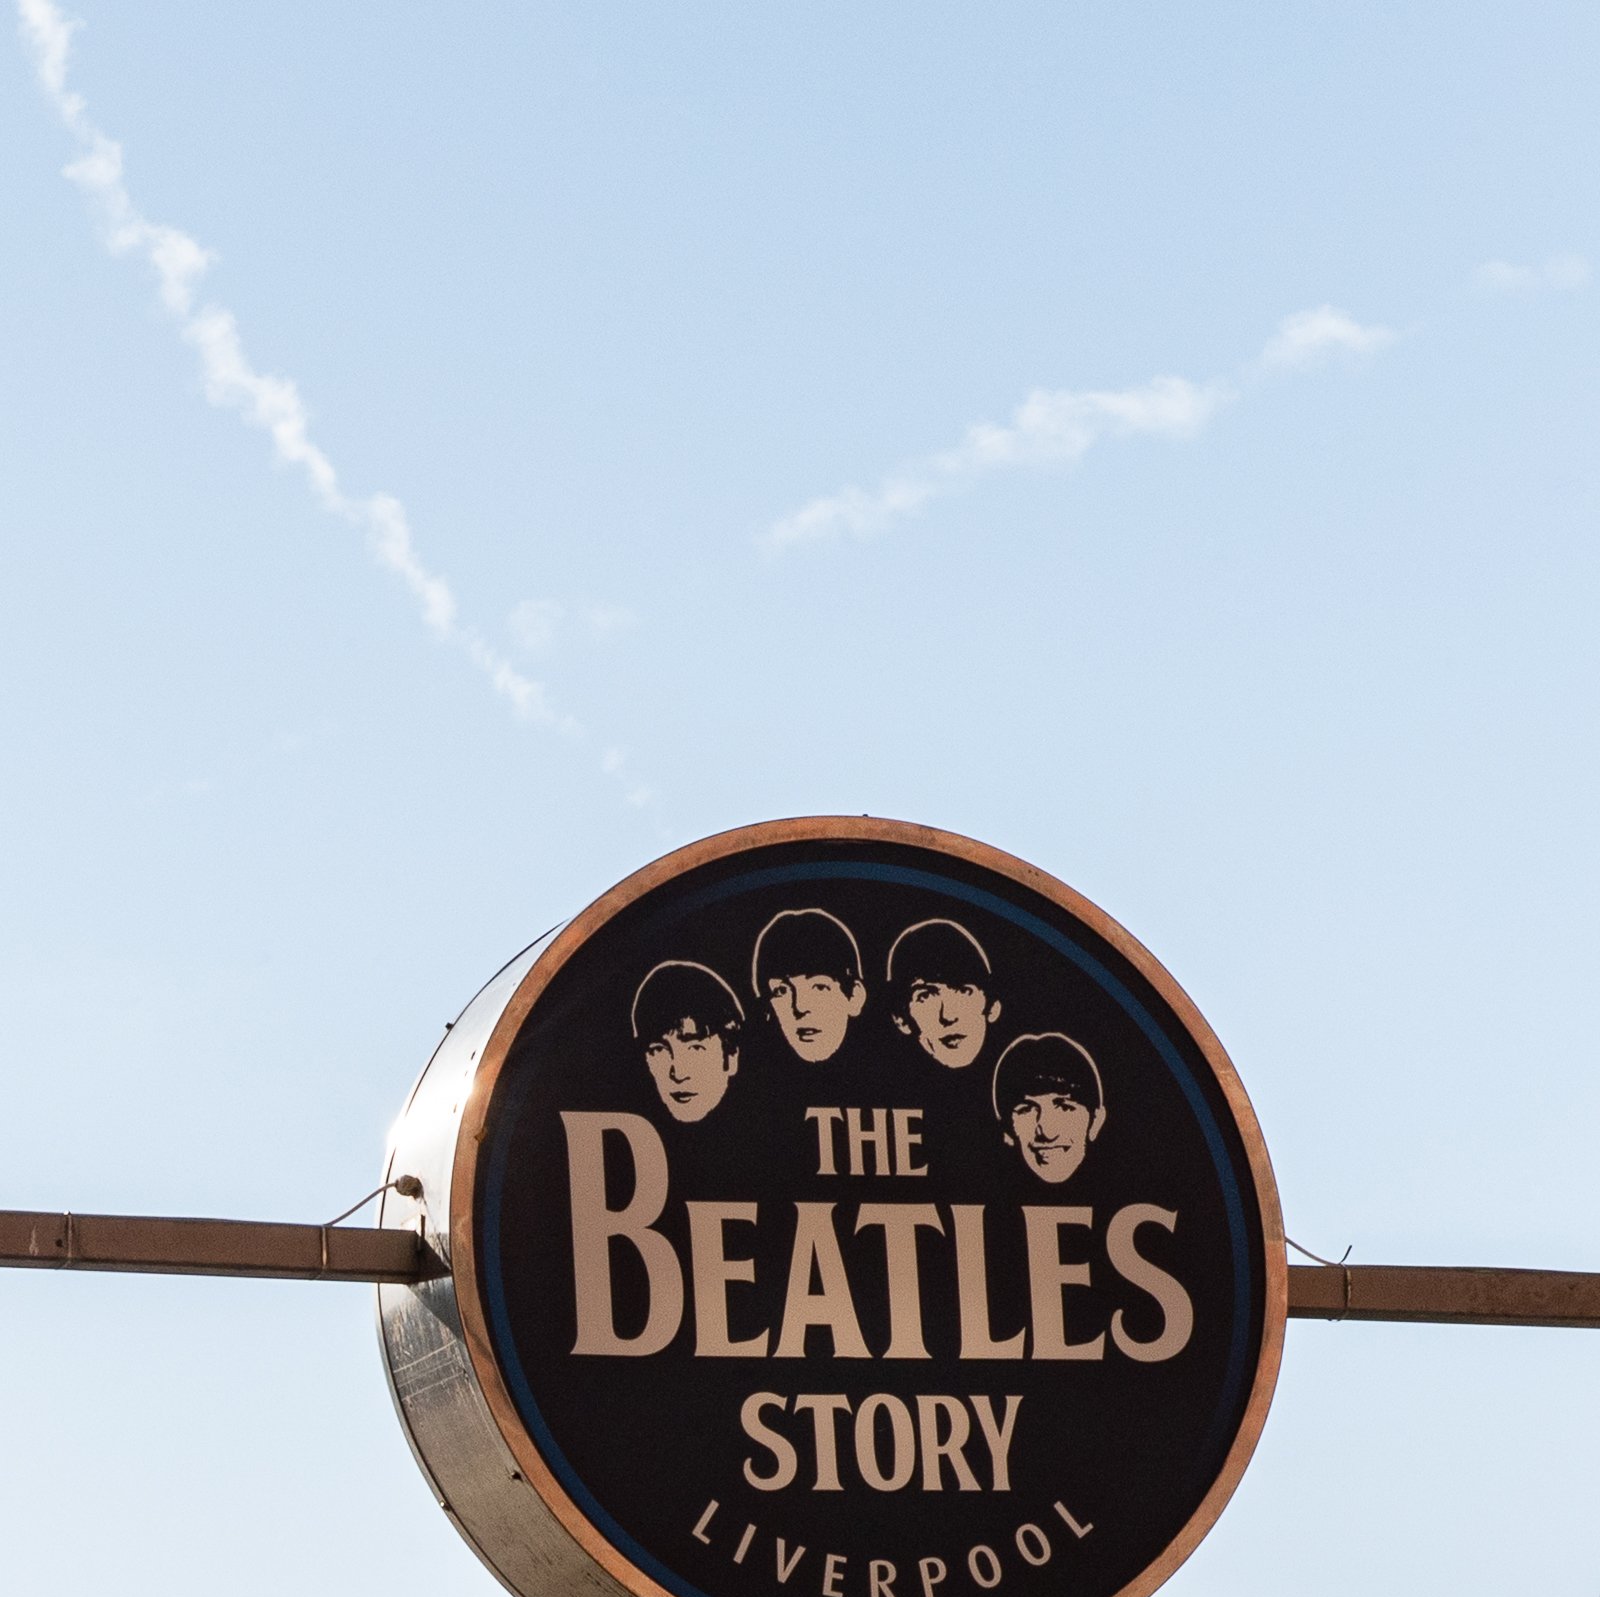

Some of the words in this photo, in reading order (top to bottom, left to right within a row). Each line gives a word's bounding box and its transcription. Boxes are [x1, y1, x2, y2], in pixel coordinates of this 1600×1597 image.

[804, 1106, 929, 1177] THE
[559, 1109, 1194, 1363] BEATLES
[738, 1390, 1024, 1492] STORY
